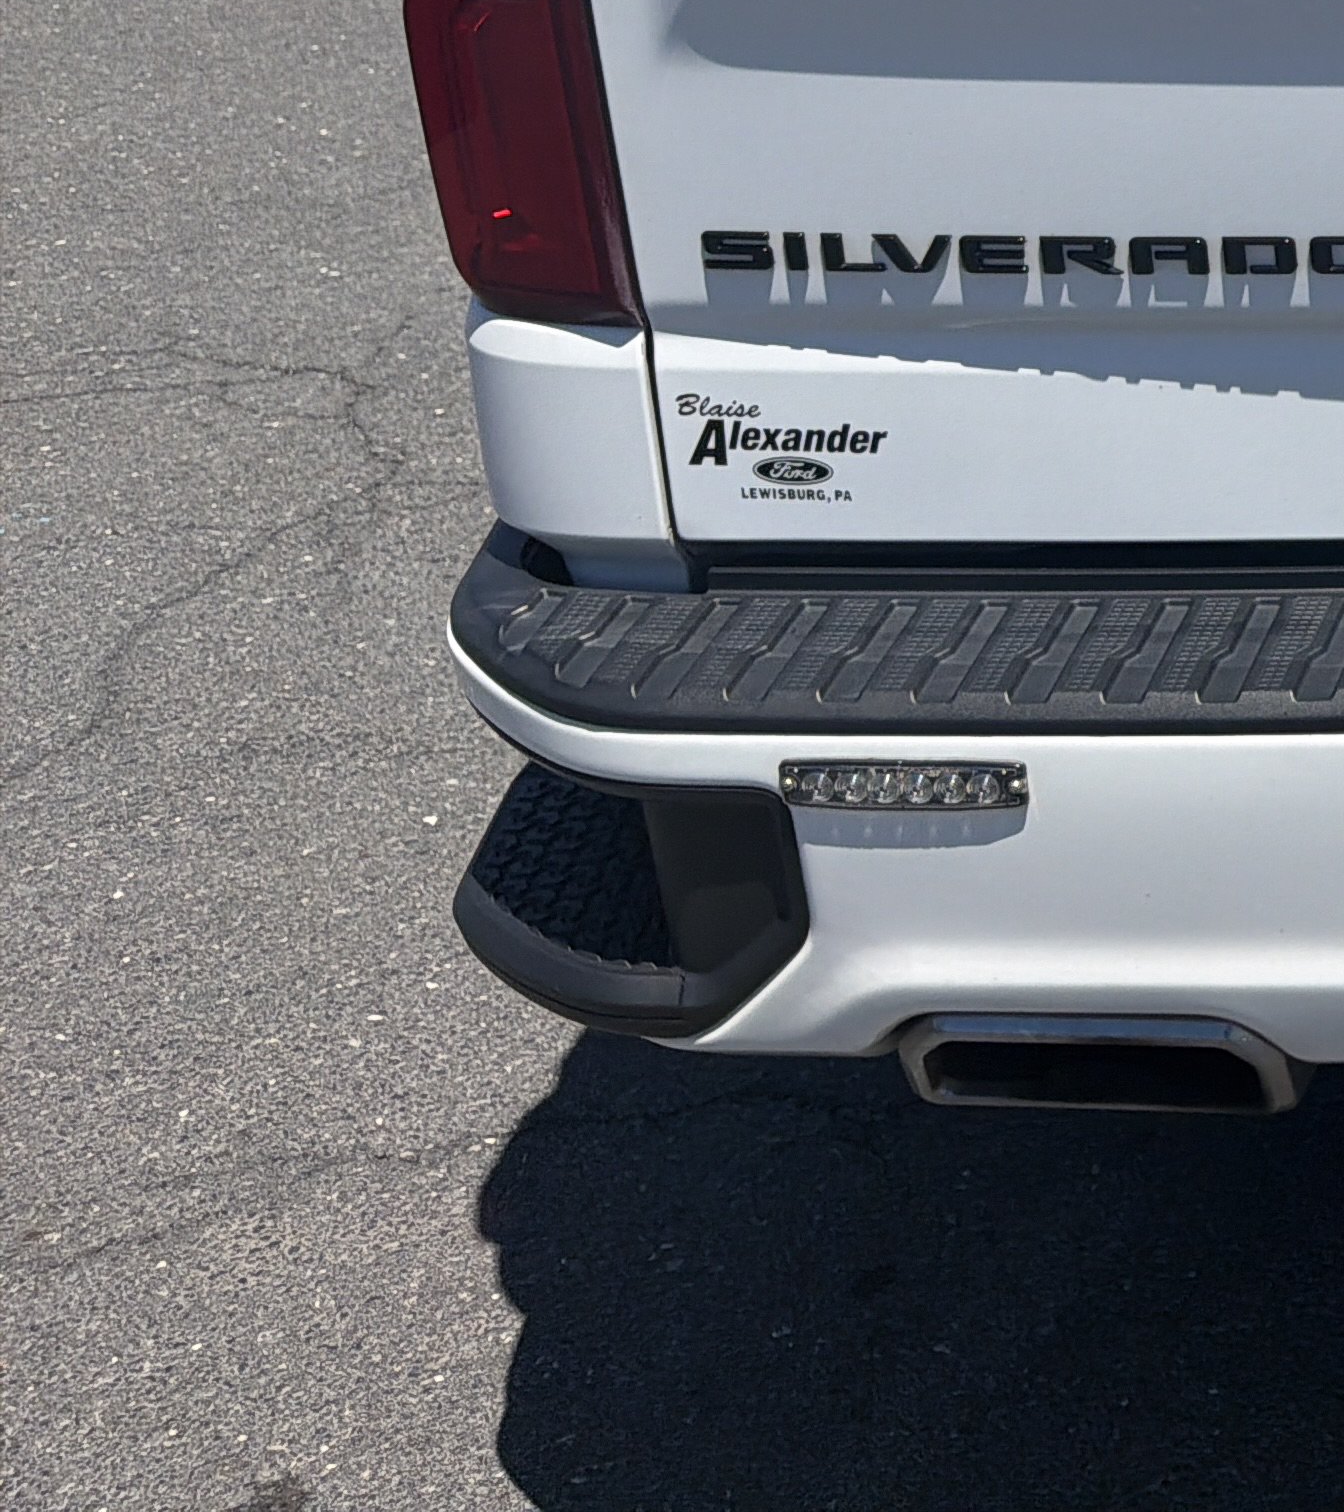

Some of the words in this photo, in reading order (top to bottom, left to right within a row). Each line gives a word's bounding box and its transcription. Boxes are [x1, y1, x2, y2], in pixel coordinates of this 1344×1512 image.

[675, 393, 761, 418] Blaise
[688, 419, 888, 466] Alexander
[769, 461, 817, 480] Ford
[741, 487, 832, 503] LEWISBURG,
[834, 489, 852, 502] PA
